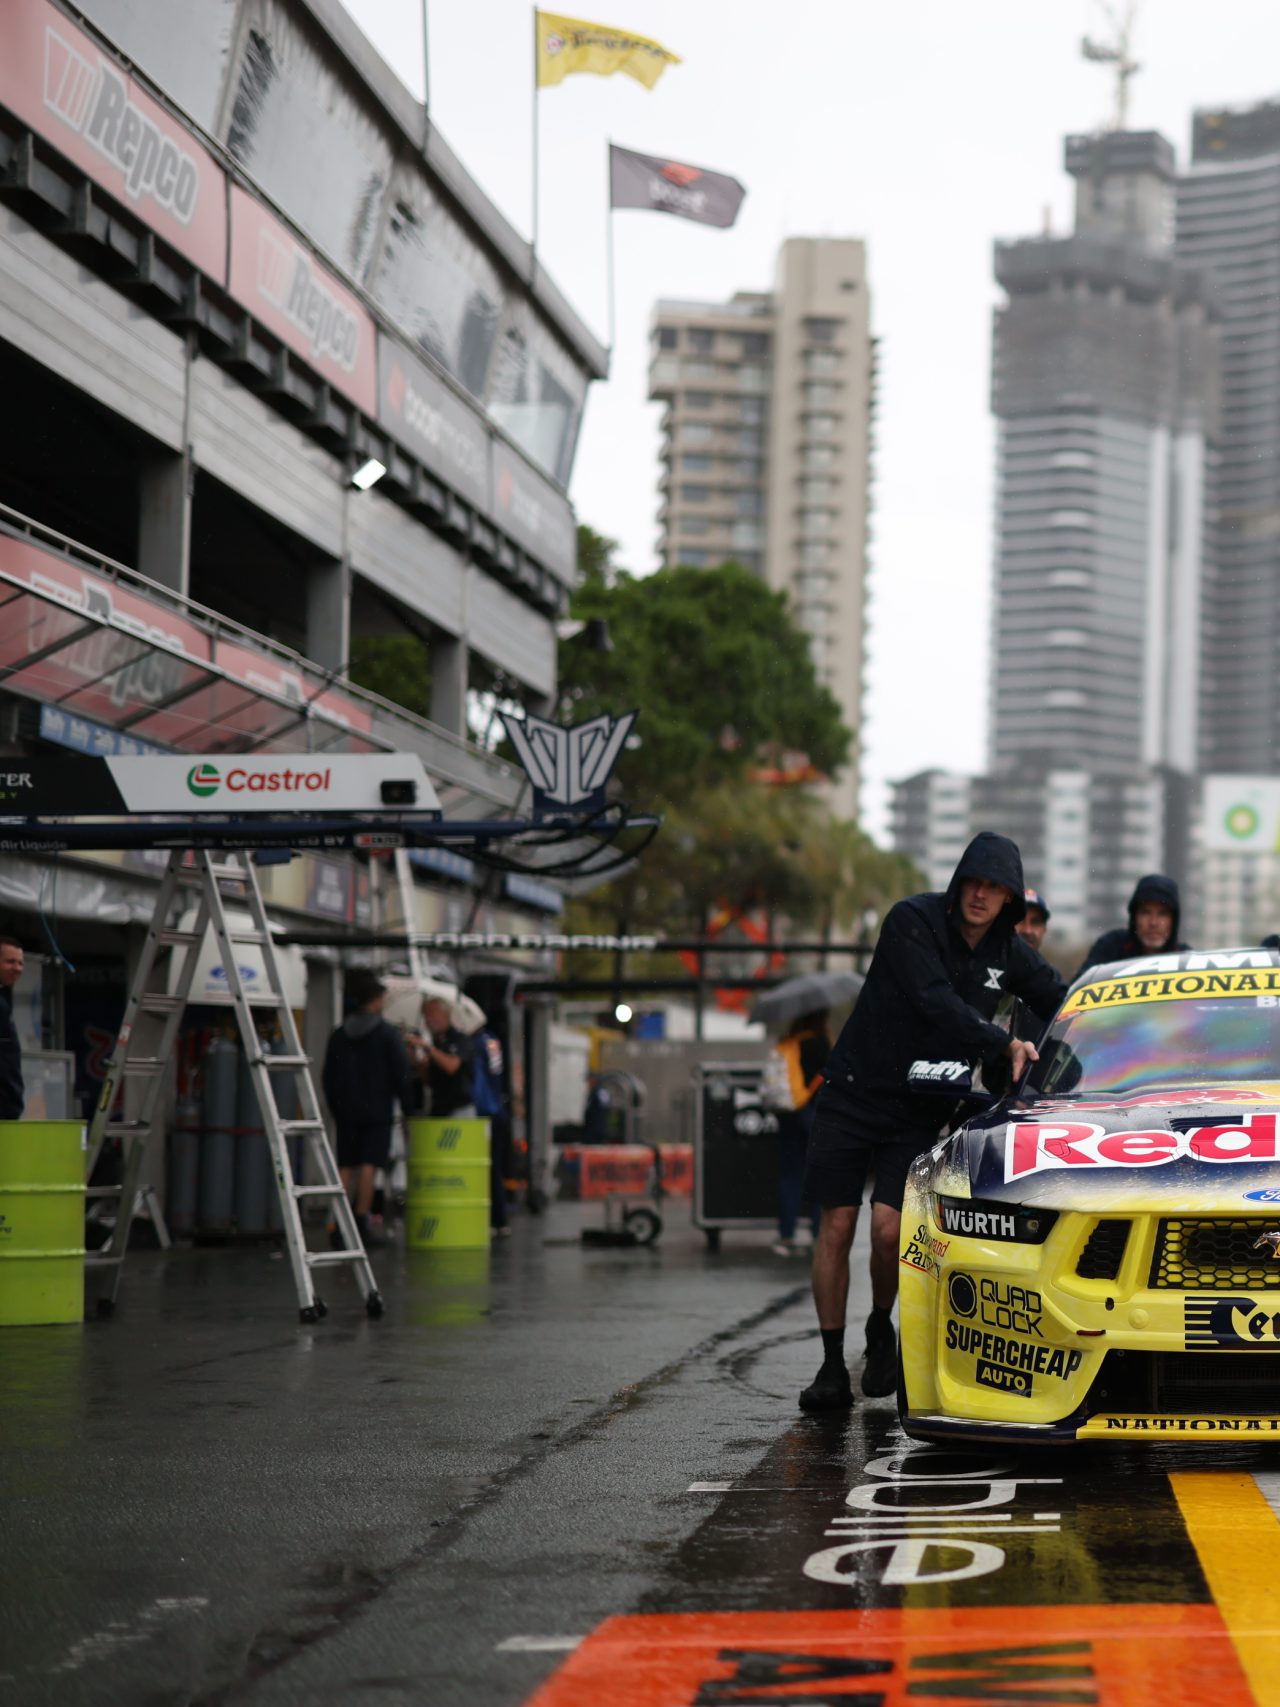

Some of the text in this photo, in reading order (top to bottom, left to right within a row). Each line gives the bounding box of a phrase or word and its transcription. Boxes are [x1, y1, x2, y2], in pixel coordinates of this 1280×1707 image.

[84, 54, 199, 224] Repco
[287, 247, 360, 373] Repco
[225, 768, 331, 792] Castrol
[908, 1060, 970, 1080] Thrifty
[945, 1208, 1015, 1237] WÜRTH
[980, 1278, 1042, 1313] QUAD
[981, 1302, 1044, 1337] LOCK
[945, 1319, 1083, 1380] SUPERCHEAP
[981, 1366, 1026, 1391] AUTO
